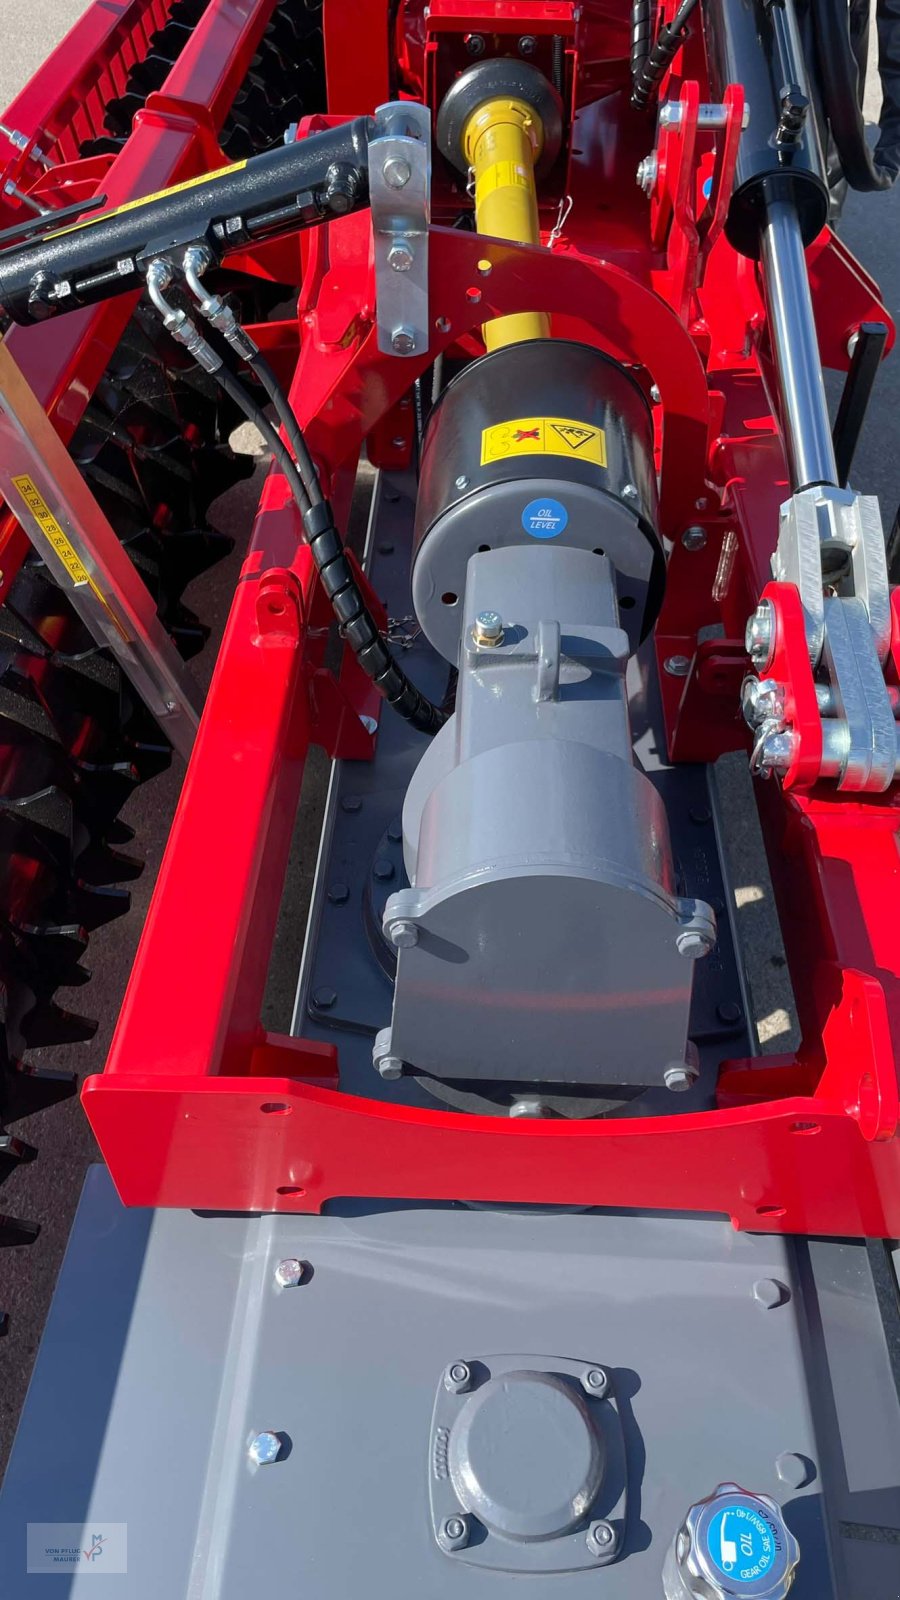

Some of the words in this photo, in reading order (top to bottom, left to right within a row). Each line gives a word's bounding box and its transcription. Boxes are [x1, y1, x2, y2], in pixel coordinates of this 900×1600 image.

[21, 484, 32, 493] 34
[30, 498, 41, 507] 32
[38, 511, 49, 519] 30
[537, 509, 552, 517] OIL
[46, 524, 57, 532] 28
[530, 521, 556, 529] LEVEL
[62, 550, 72, 558] 24
[70, 562, 80, 570] 22
[740, 1532, 752, 1556] OIL
[762, 1536, 771, 1552] SAE
[759, 1555, 770, 1568] OIL
[740, 1566, 761, 1578] GEAR
